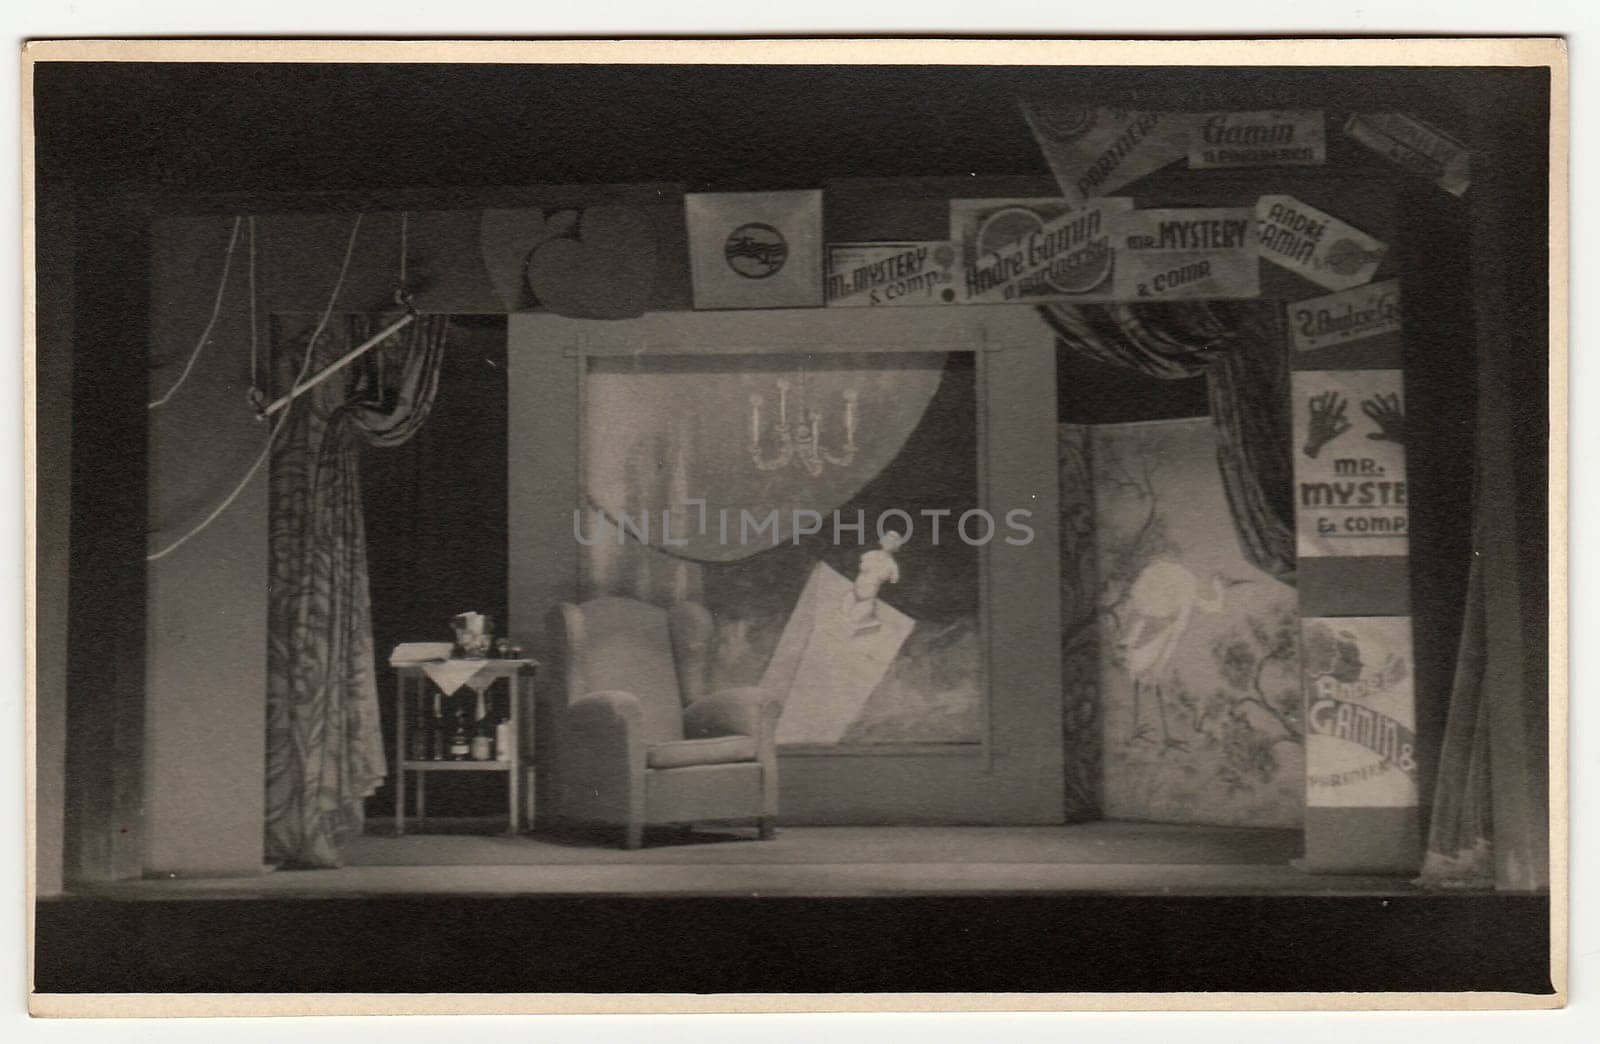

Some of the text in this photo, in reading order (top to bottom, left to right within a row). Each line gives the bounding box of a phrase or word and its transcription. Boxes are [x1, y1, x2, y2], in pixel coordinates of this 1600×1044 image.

[1202, 113, 1294, 145] Gamin
[1028, 205, 1101, 267] Gamin
[1159, 219, 1248, 249] MYSTERY
[853, 246, 928, 294] MYSTERY
[1301, 481, 1406, 506] MYSTE
[1317, 515, 1406, 533] & COMP
